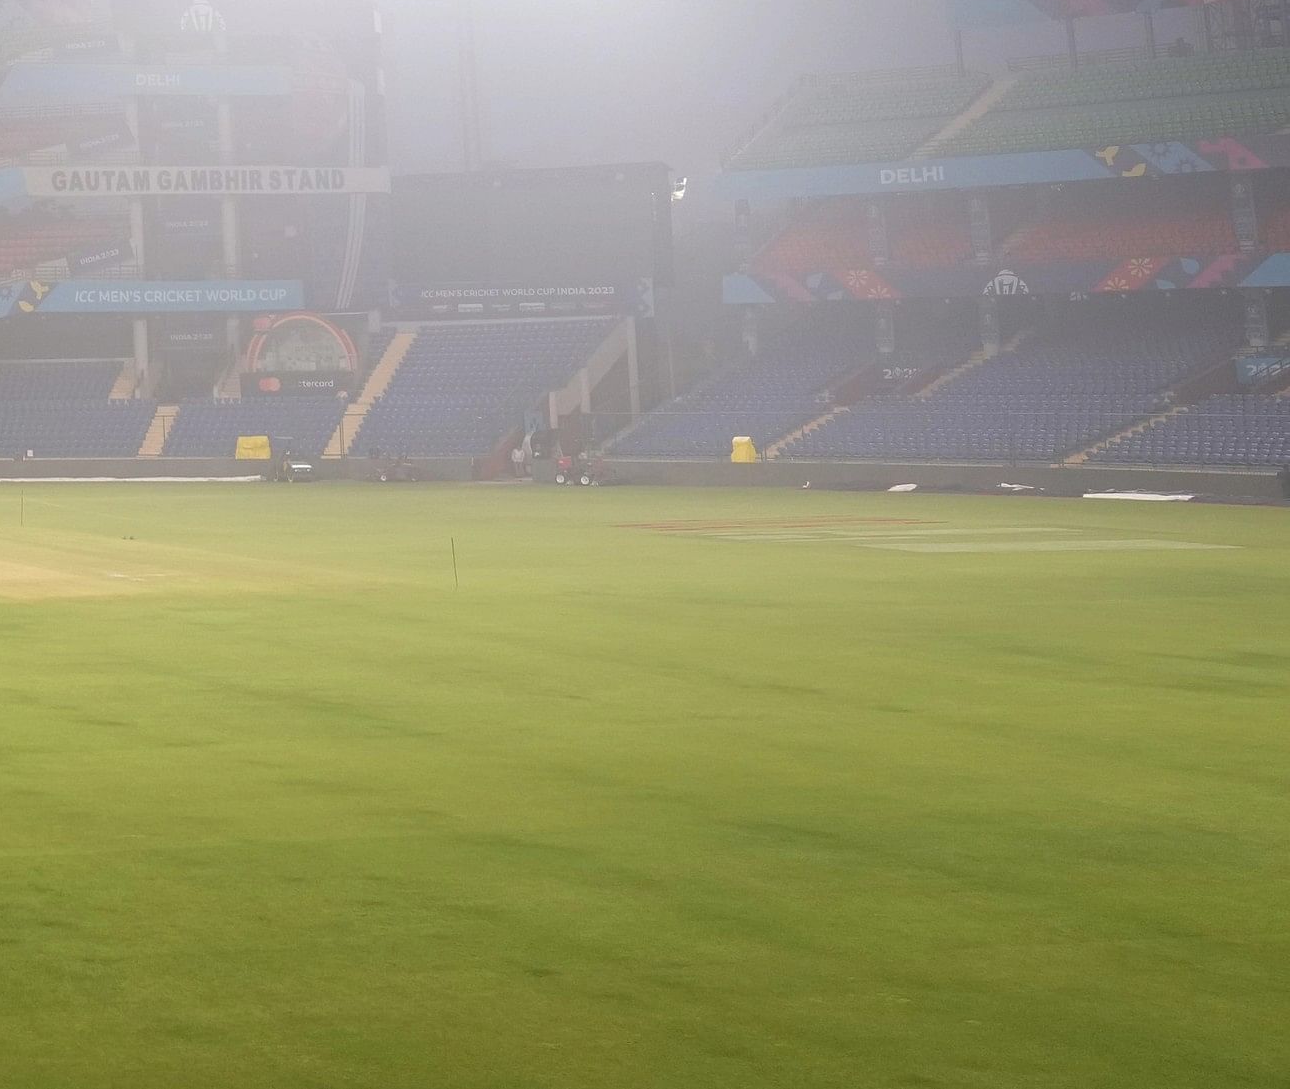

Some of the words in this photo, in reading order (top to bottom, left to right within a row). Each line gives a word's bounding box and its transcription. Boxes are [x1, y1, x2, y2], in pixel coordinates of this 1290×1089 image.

[135, 72, 181, 86] DELHI
[51, 170, 151, 192] GAUTAM
[157, 169, 264, 192] GAMBHIR
[270, 169, 345, 191] STAND
[880, 165, 945, 185] DELHI
[75, 289, 95, 303] ICC
[98, 289, 141, 303] MEN'S
[144, 289, 202, 303] CRICKET
[205, 290, 256, 303] WORLD
[259, 288, 287, 302] CUP
[463, 289, 499, 298] CRICKET
[502, 288, 535, 297] WORLD
[536, 287, 555, 296] CUP
[556, 286, 587, 295] INDIA
[587, 286, 615, 295] 2023
